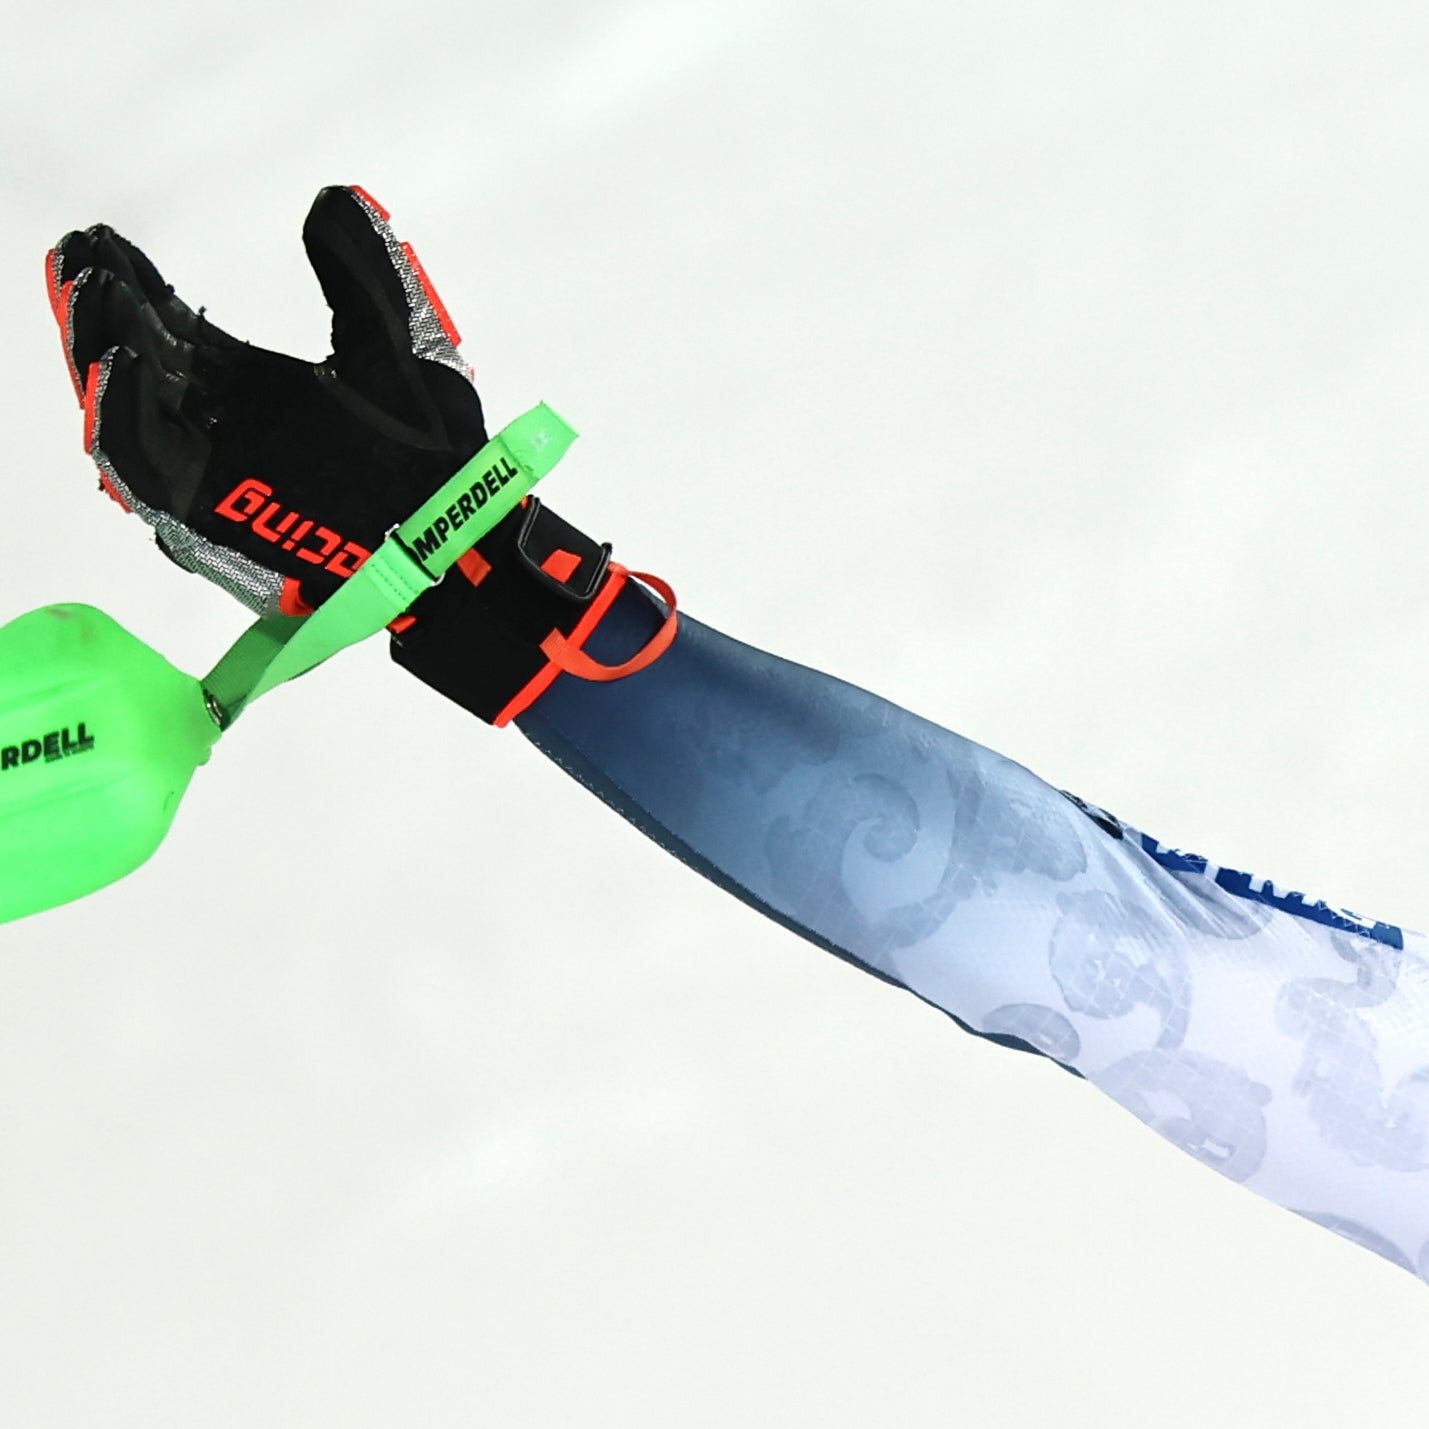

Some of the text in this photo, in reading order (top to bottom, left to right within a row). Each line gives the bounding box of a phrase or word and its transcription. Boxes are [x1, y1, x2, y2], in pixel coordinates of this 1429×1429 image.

[214, 477, 373, 579] acing
[412, 457, 519, 562] MPERDELL
[0, 722, 95, 771] RDELL
